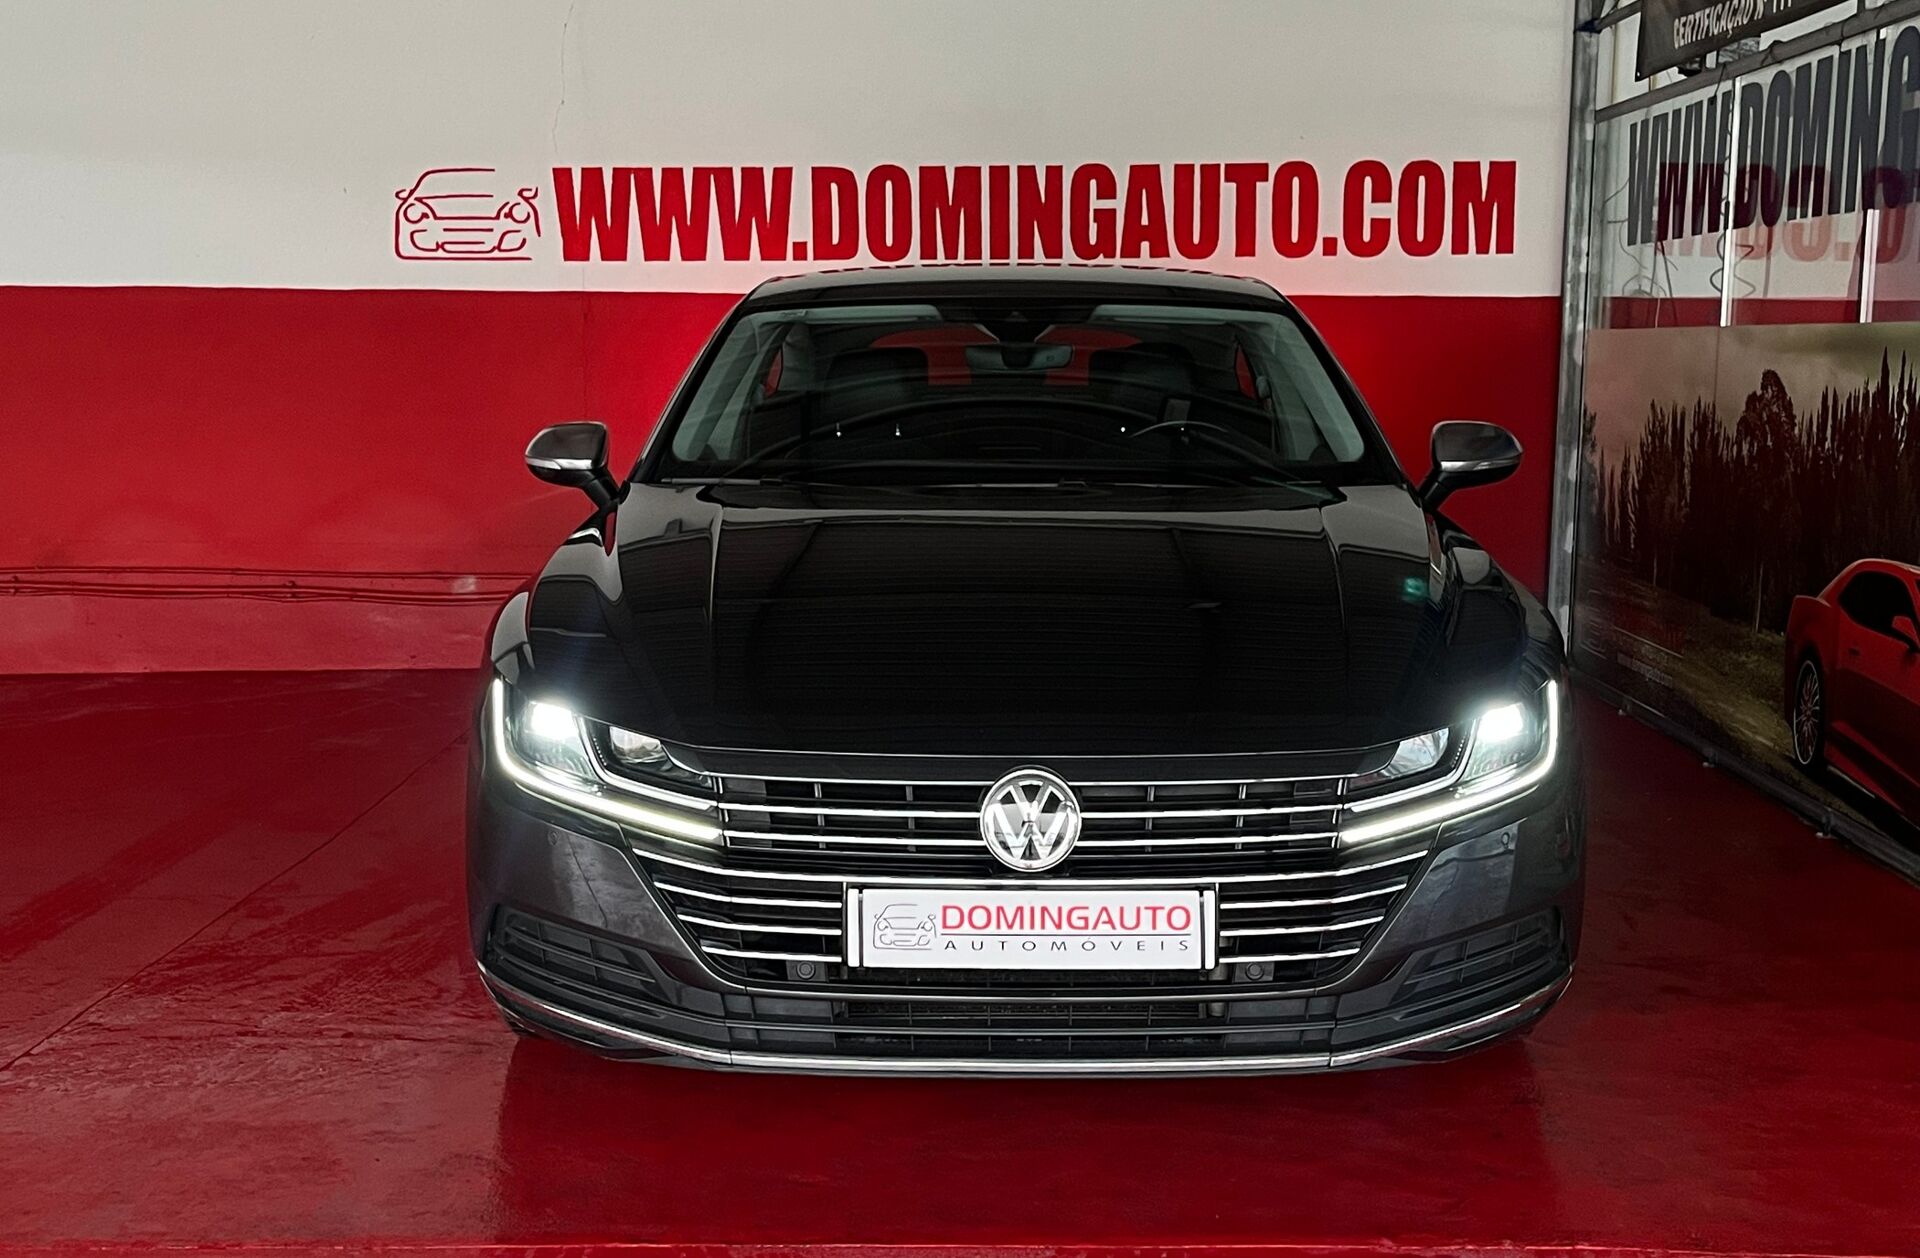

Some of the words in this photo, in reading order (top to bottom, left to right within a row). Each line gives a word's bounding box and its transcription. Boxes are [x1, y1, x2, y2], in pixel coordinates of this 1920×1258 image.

[552, 160, 1516, 262] WWW.DOMINGAUTO.COM
[941, 905, 1191, 931] DOMINGAUTO
[944, 937, 1189, 951] AUTOMÓVEIS
